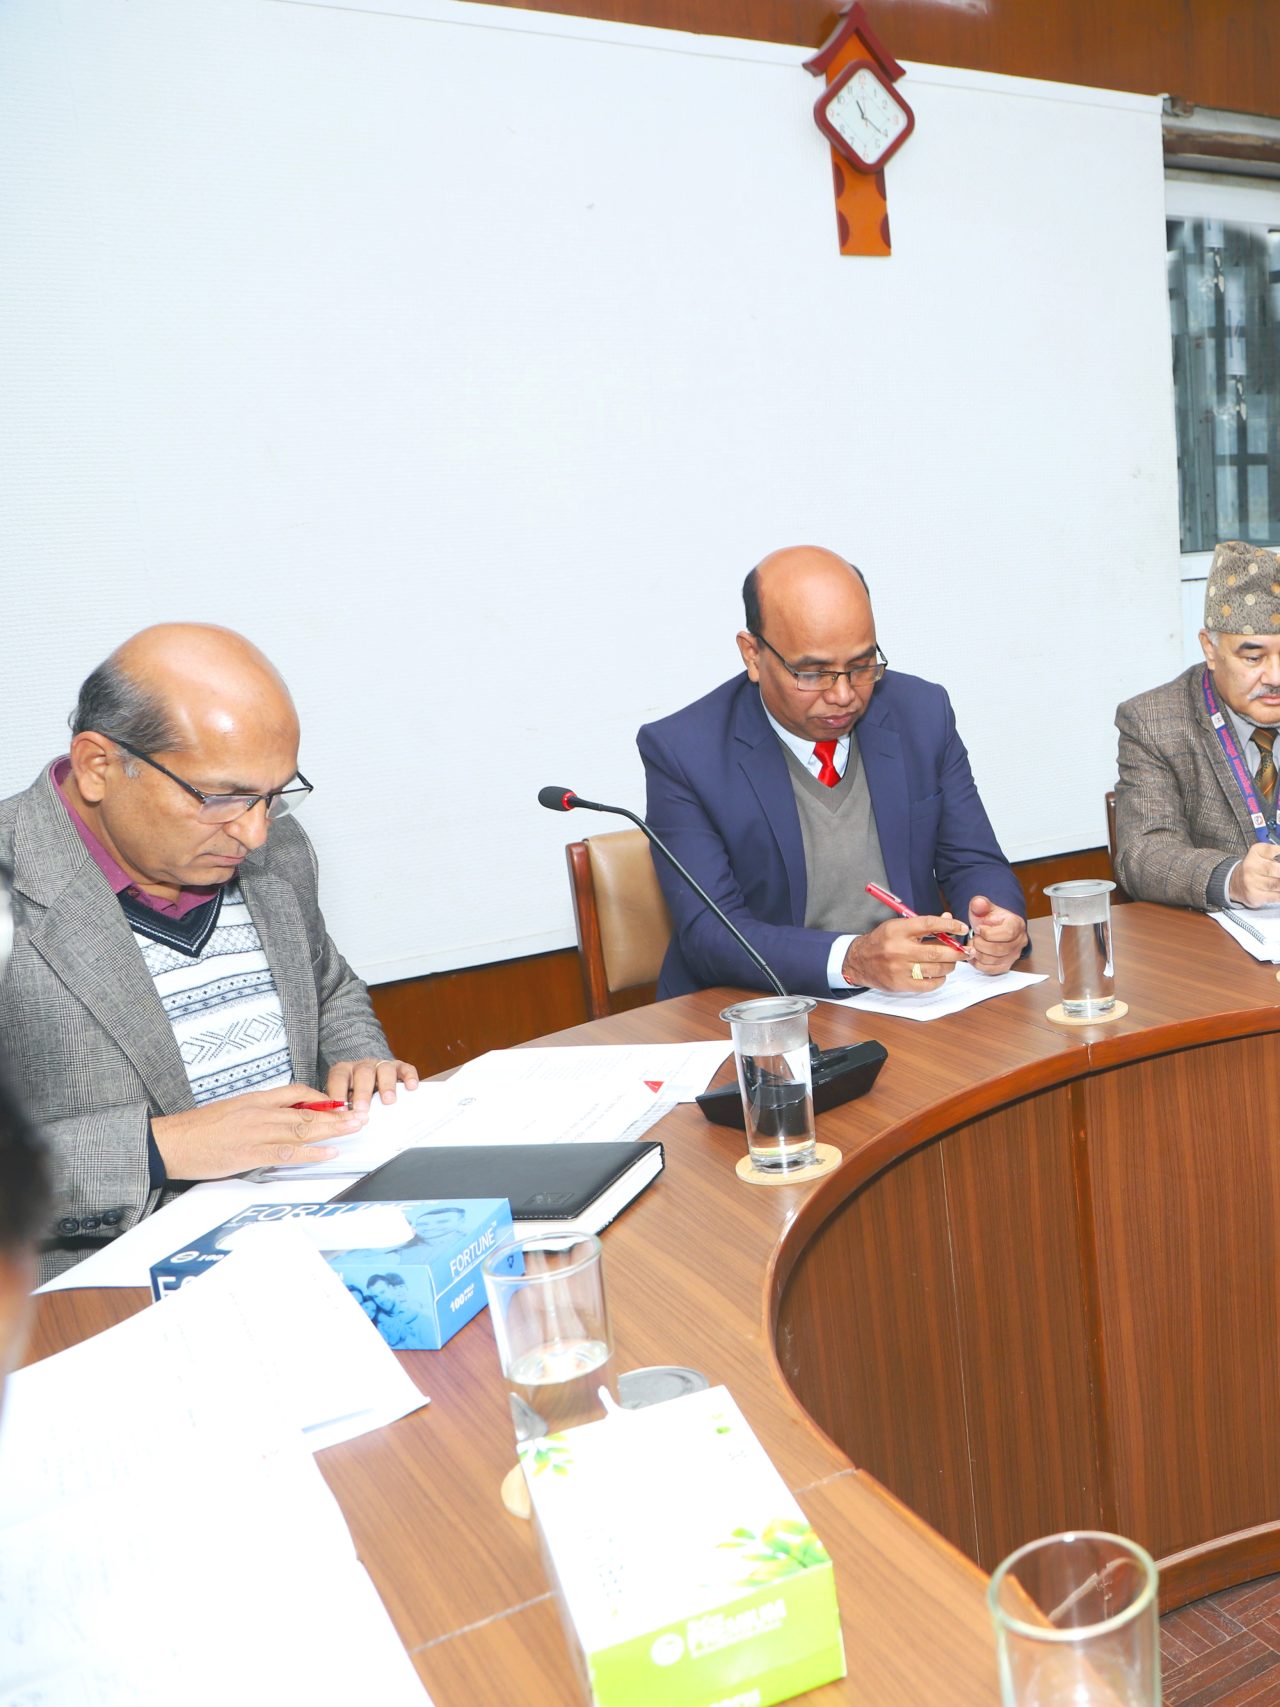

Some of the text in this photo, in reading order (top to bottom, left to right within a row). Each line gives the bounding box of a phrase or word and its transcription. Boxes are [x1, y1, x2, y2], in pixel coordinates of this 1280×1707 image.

[230, 1202, 421, 1223] FORT
[449, 1227, 496, 1277] FORTUNE
[450, 1293, 465, 1312] 100
